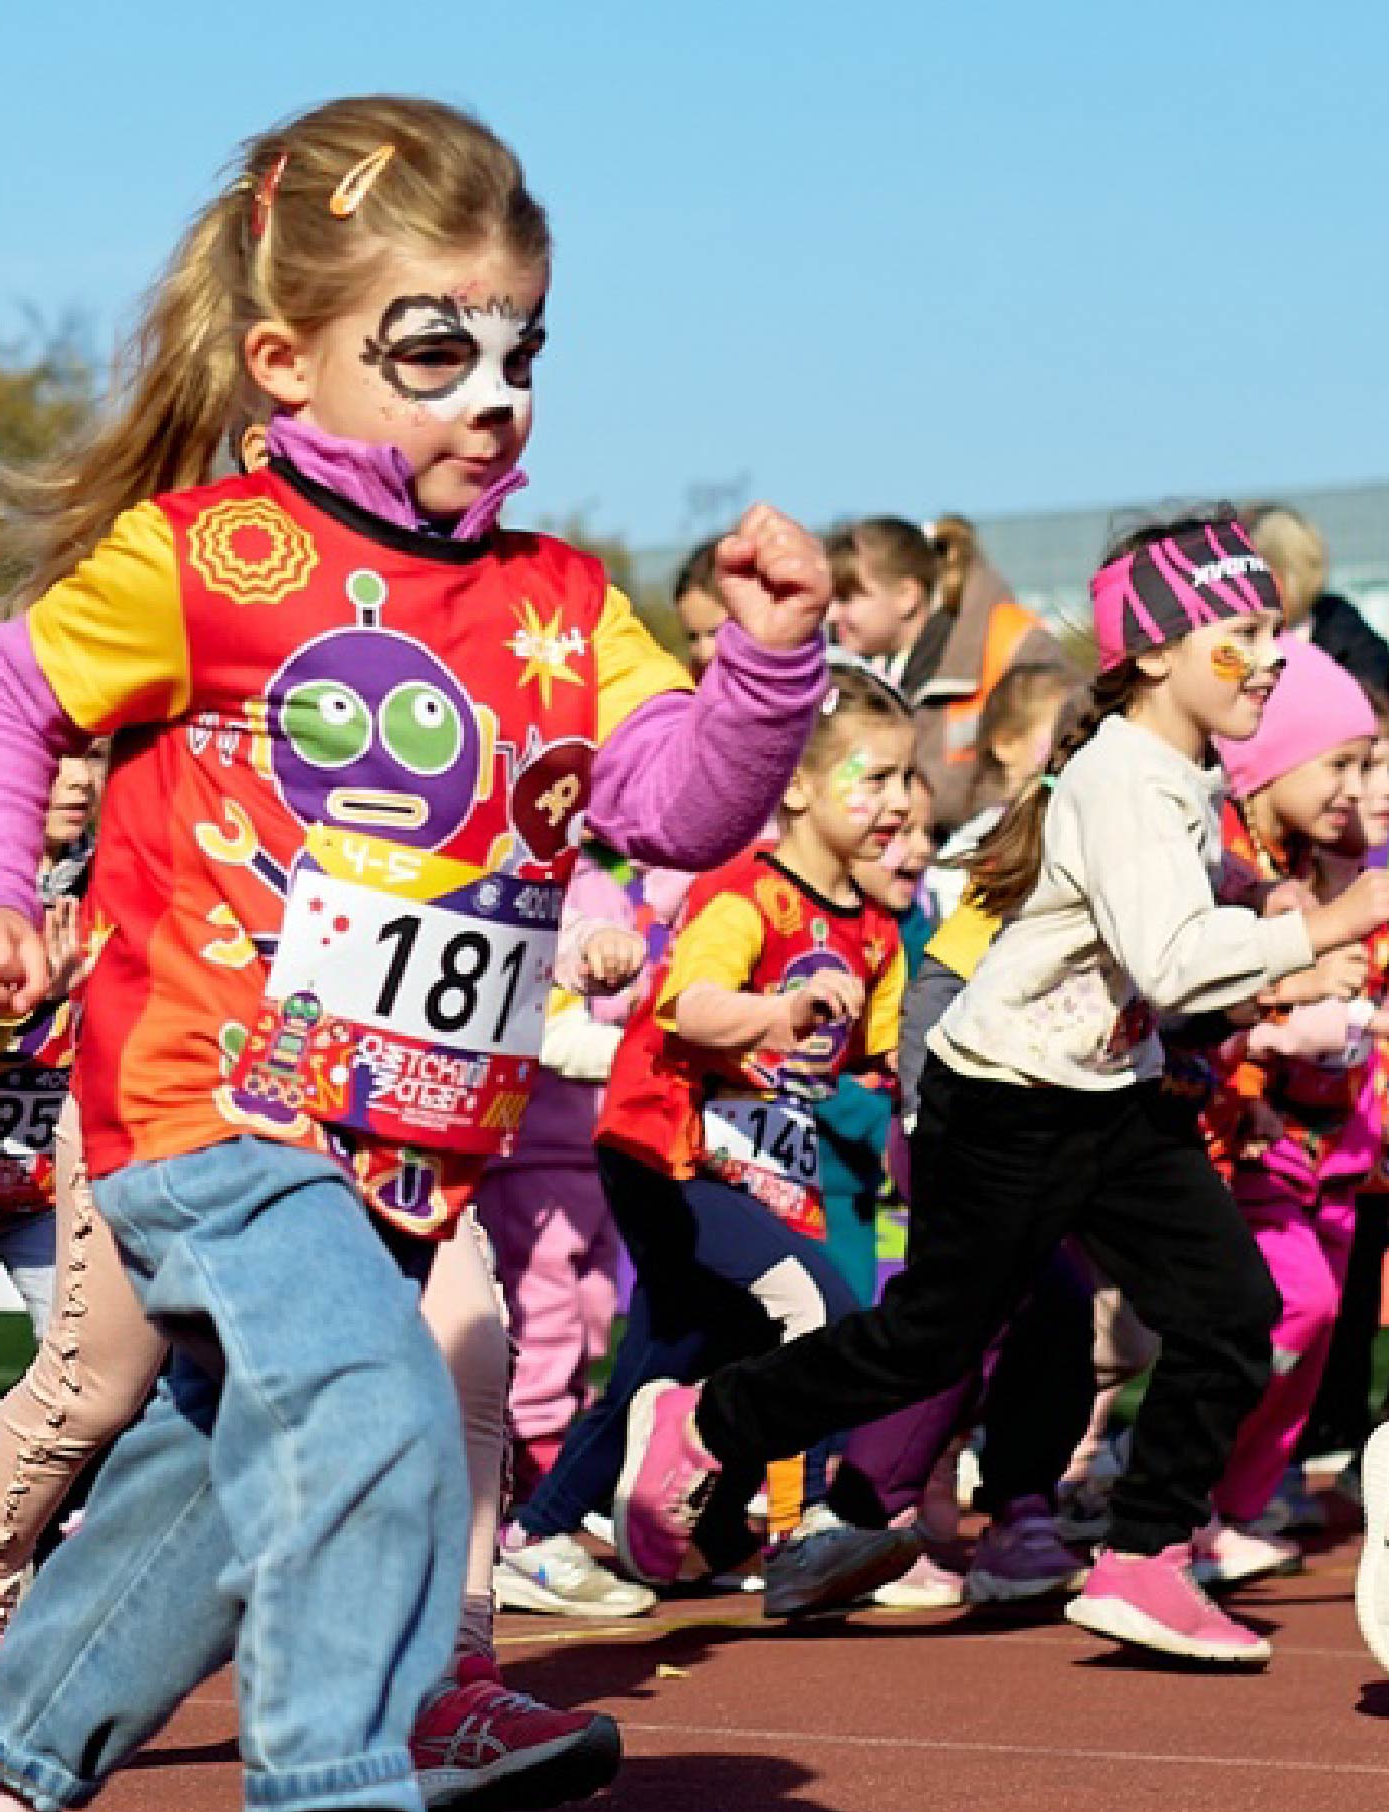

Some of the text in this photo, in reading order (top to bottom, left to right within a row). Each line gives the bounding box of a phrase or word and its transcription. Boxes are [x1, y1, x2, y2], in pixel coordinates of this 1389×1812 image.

[342, 838, 422, 883] 4-5
[376, 914, 527, 1045] 181
[352, 1034, 492, 1088] ДЕТСКИЙ
[747, 1107, 818, 1178] 145
